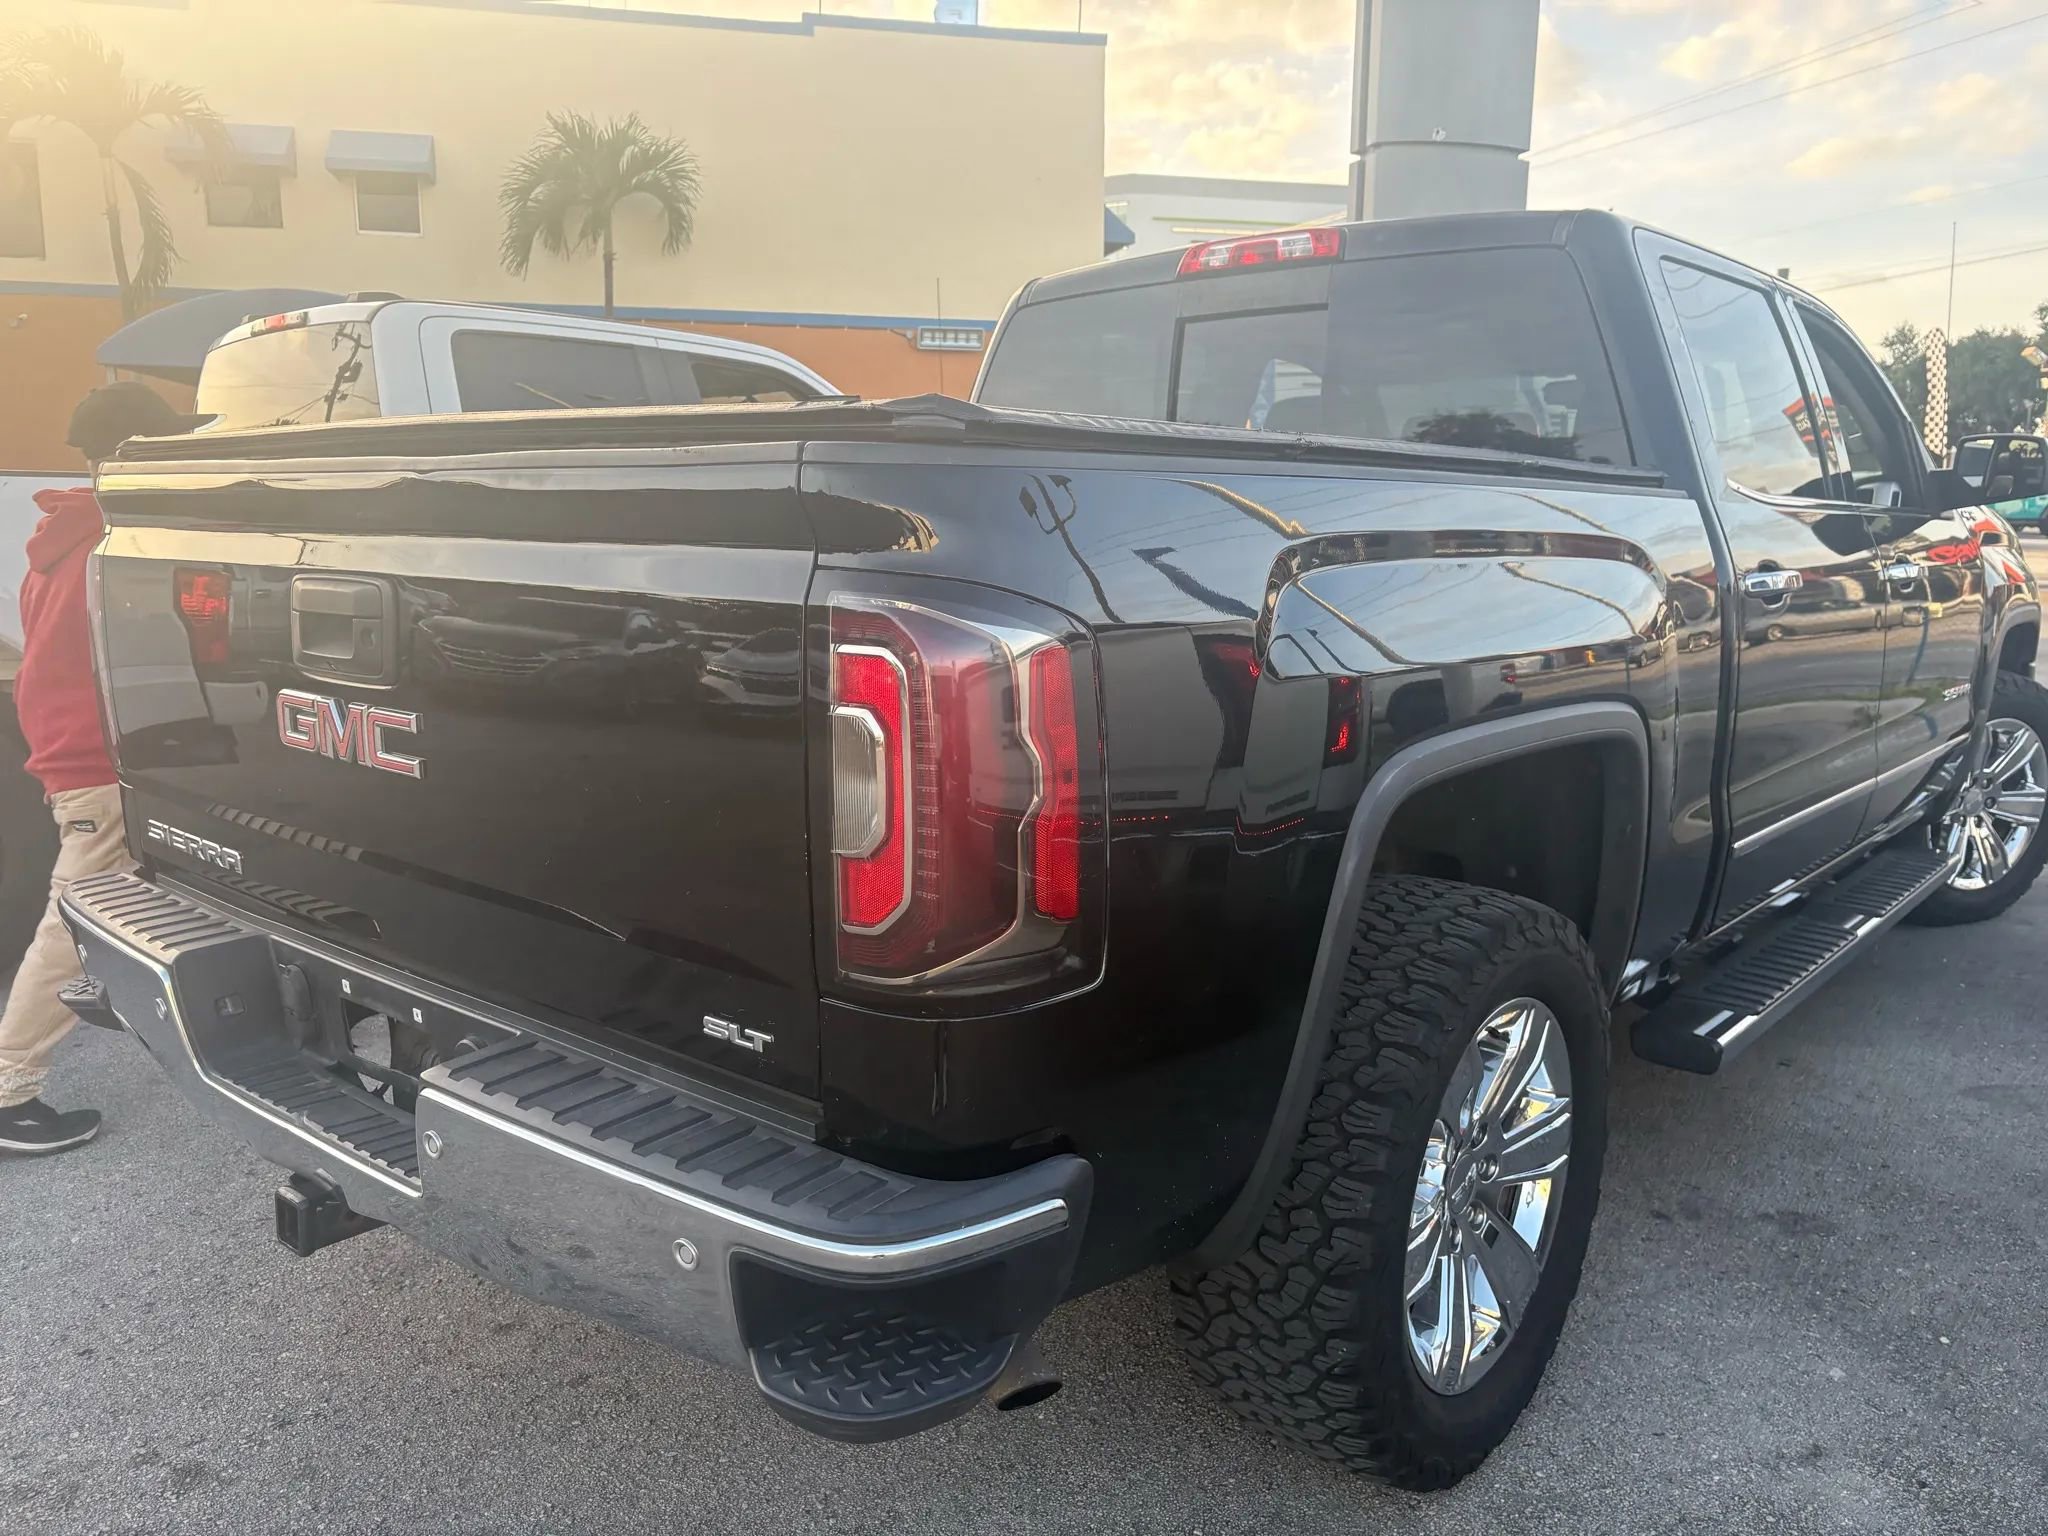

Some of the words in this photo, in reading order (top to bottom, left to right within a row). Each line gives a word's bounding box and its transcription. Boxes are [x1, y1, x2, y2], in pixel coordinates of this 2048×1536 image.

[277, 688, 426, 780] GMC
[147, 819, 243, 875] SIERRA
[702, 1015, 775, 1053] SLT
